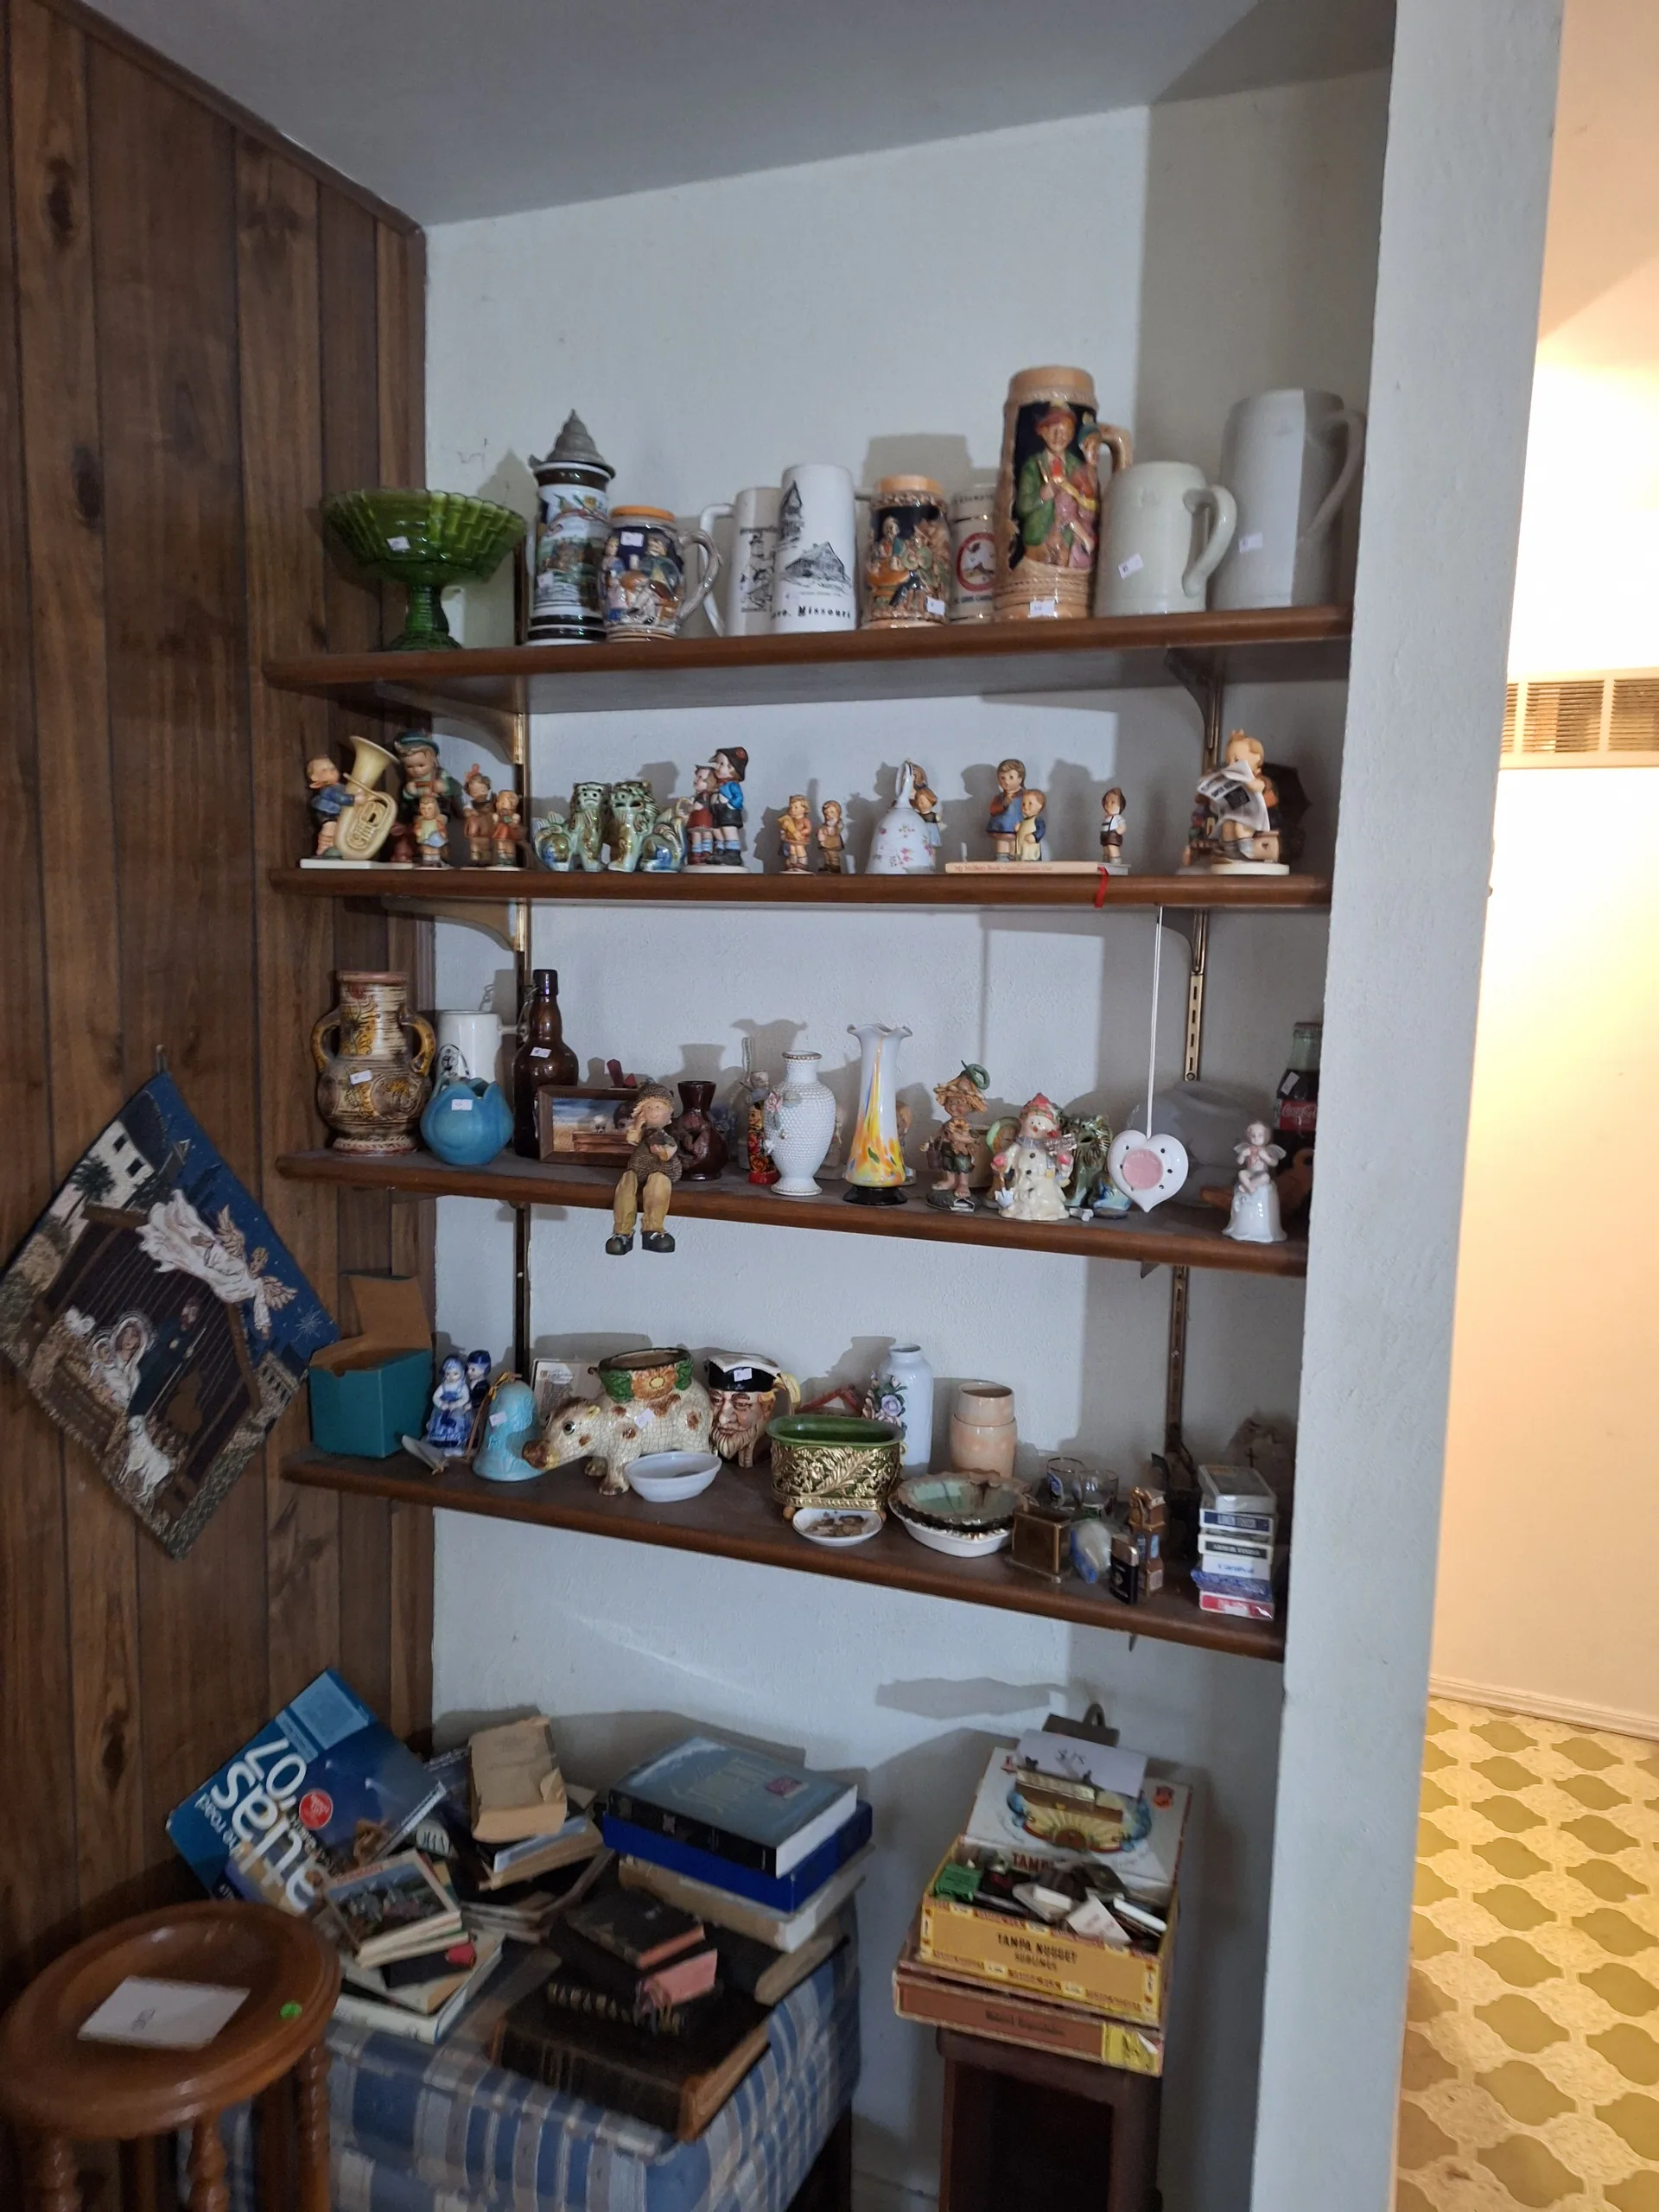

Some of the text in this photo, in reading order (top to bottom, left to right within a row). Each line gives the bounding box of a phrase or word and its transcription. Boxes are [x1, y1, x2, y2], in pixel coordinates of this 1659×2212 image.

[798, 605, 851, 620] Missouri
[194, 1791, 227, 1834] road
[211, 1761, 323, 1913] atlas
[997, 1933, 1078, 1965] TAMPA NUGGET
